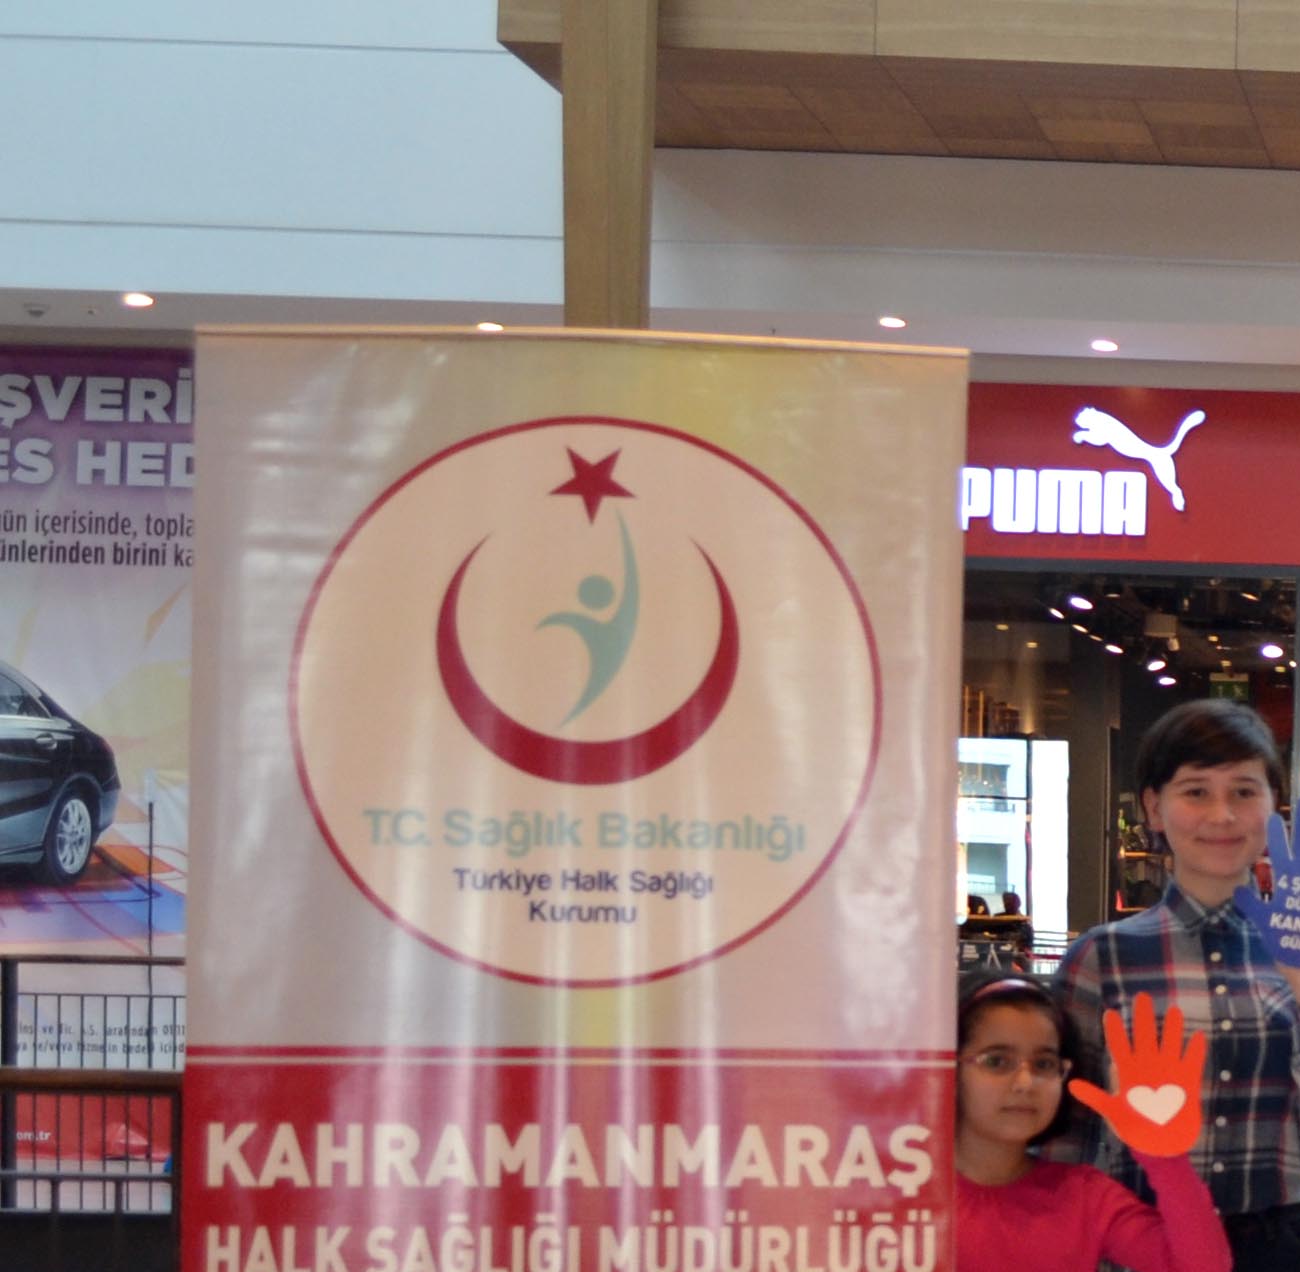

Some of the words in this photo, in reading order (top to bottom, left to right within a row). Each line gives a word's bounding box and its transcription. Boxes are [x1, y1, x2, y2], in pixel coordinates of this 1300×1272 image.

[0, 438, 53, 484] S
[961, 467, 1147, 536] PUMA
[443, 809, 582, 859] Sağlık
[599, 812, 807, 863] Bakanlığı
[453, 868, 553, 894] Türkiye
[561, 869, 618, 893] Halk
[630, 871, 715, 899] Sağlığı
[1278, 875, 1288, 889] 4
[529, 903, 638, 925] Kurumu
[206, 1121, 935, 1197] KAHRAMANMARAŞ
